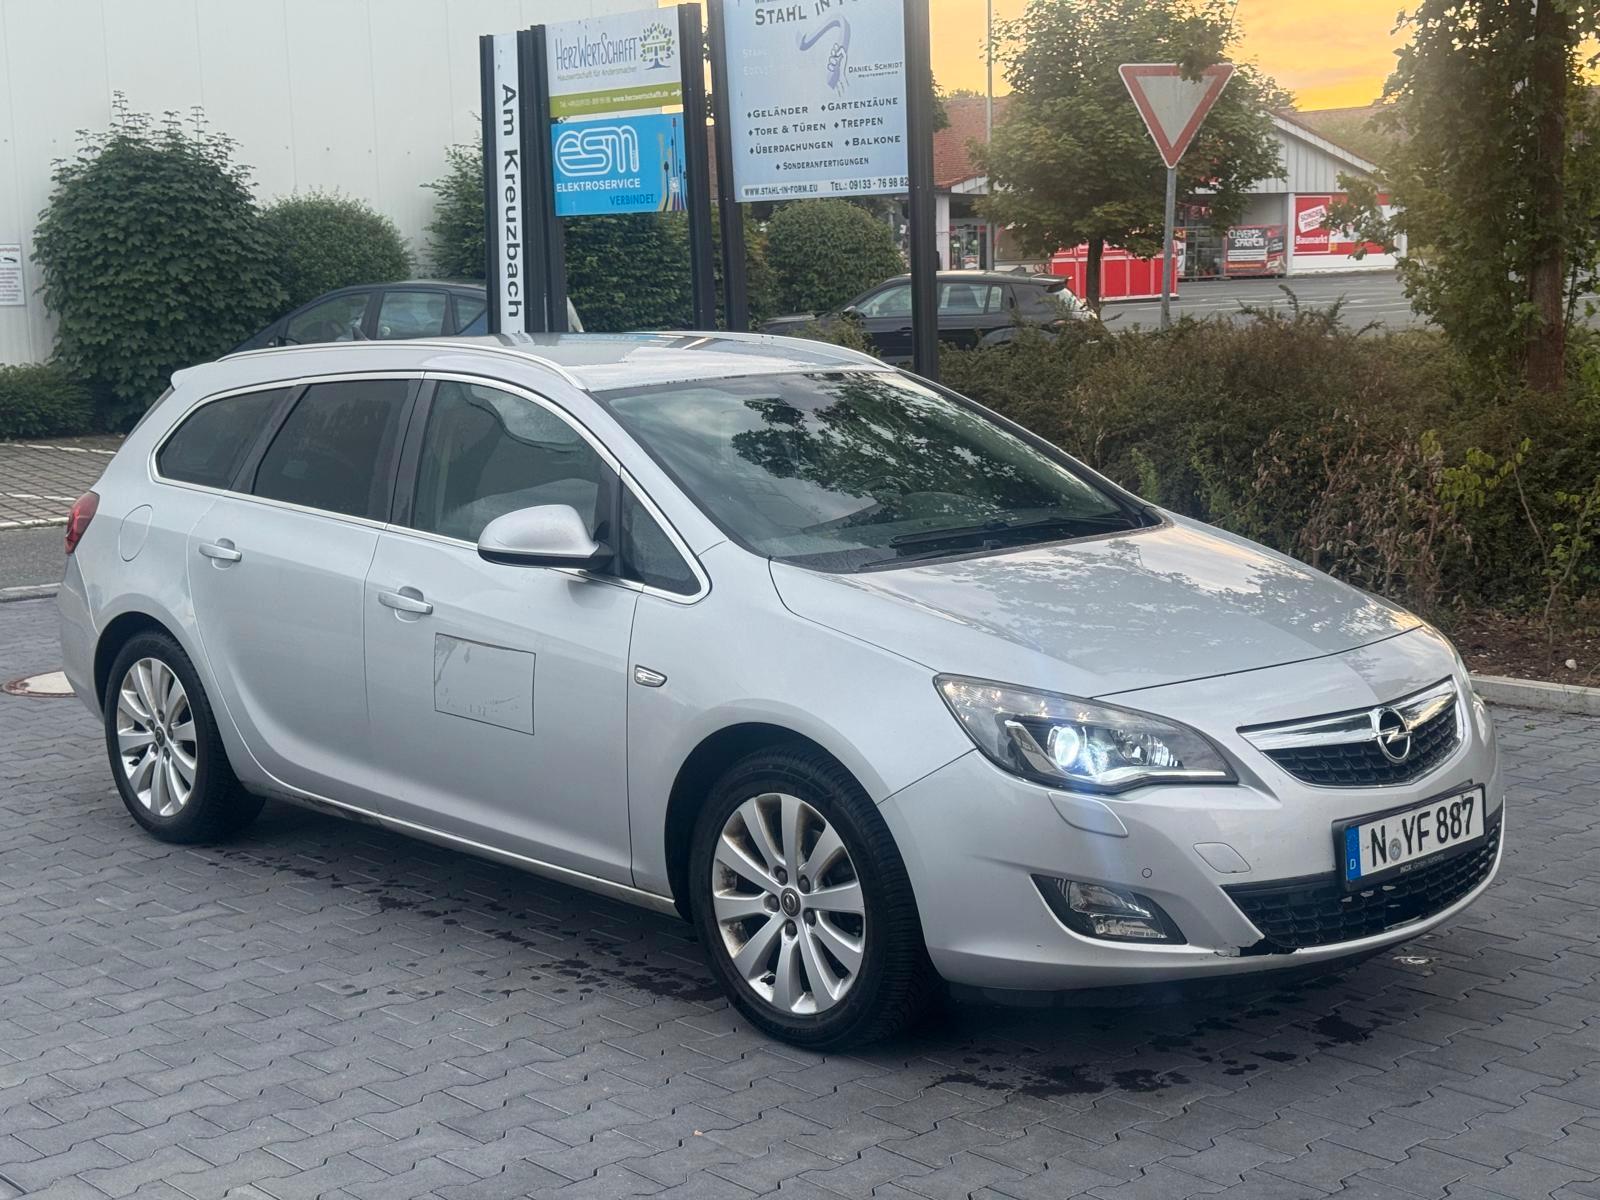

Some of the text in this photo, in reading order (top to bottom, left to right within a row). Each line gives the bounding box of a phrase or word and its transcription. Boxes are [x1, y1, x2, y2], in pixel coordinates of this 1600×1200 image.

[754, 5, 808, 26] STAHL
[848, 62, 903, 74] DANIEL SCHMIDT
[827, 97, 899, 111] GARTENZÄUNE
[752, 106, 809, 118] GELÄNDER
[754, 122, 827, 136] TORE & TÜREN
[841, 117, 884, 129] TREPPEN
[852, 135, 901, 146] BALKONE
[755, 141, 834, 155] ÜBERDACHUNGEN
[782, 157, 870, 170] SONDERANFERTIGUNGEN
[556, 178, 640, 192] ELEKTROSERVICE
[848, 178, 872, 190] 09133
[877, 177, 887, 188] 76
[888, 177, 898, 188] 98
[744, 184, 819, 197] WWW.STAHL-IN-FORM.EU
[502, 84, 522, 317] Am Kreuzbach
[1295, 235, 1328, 244] Baumarkt
[1371, 825, 1387, 867] N
[1402, 811, 1430, 855] YF
[1436, 796, 1474, 844] 887
[1350, 859, 1357, 870] D
